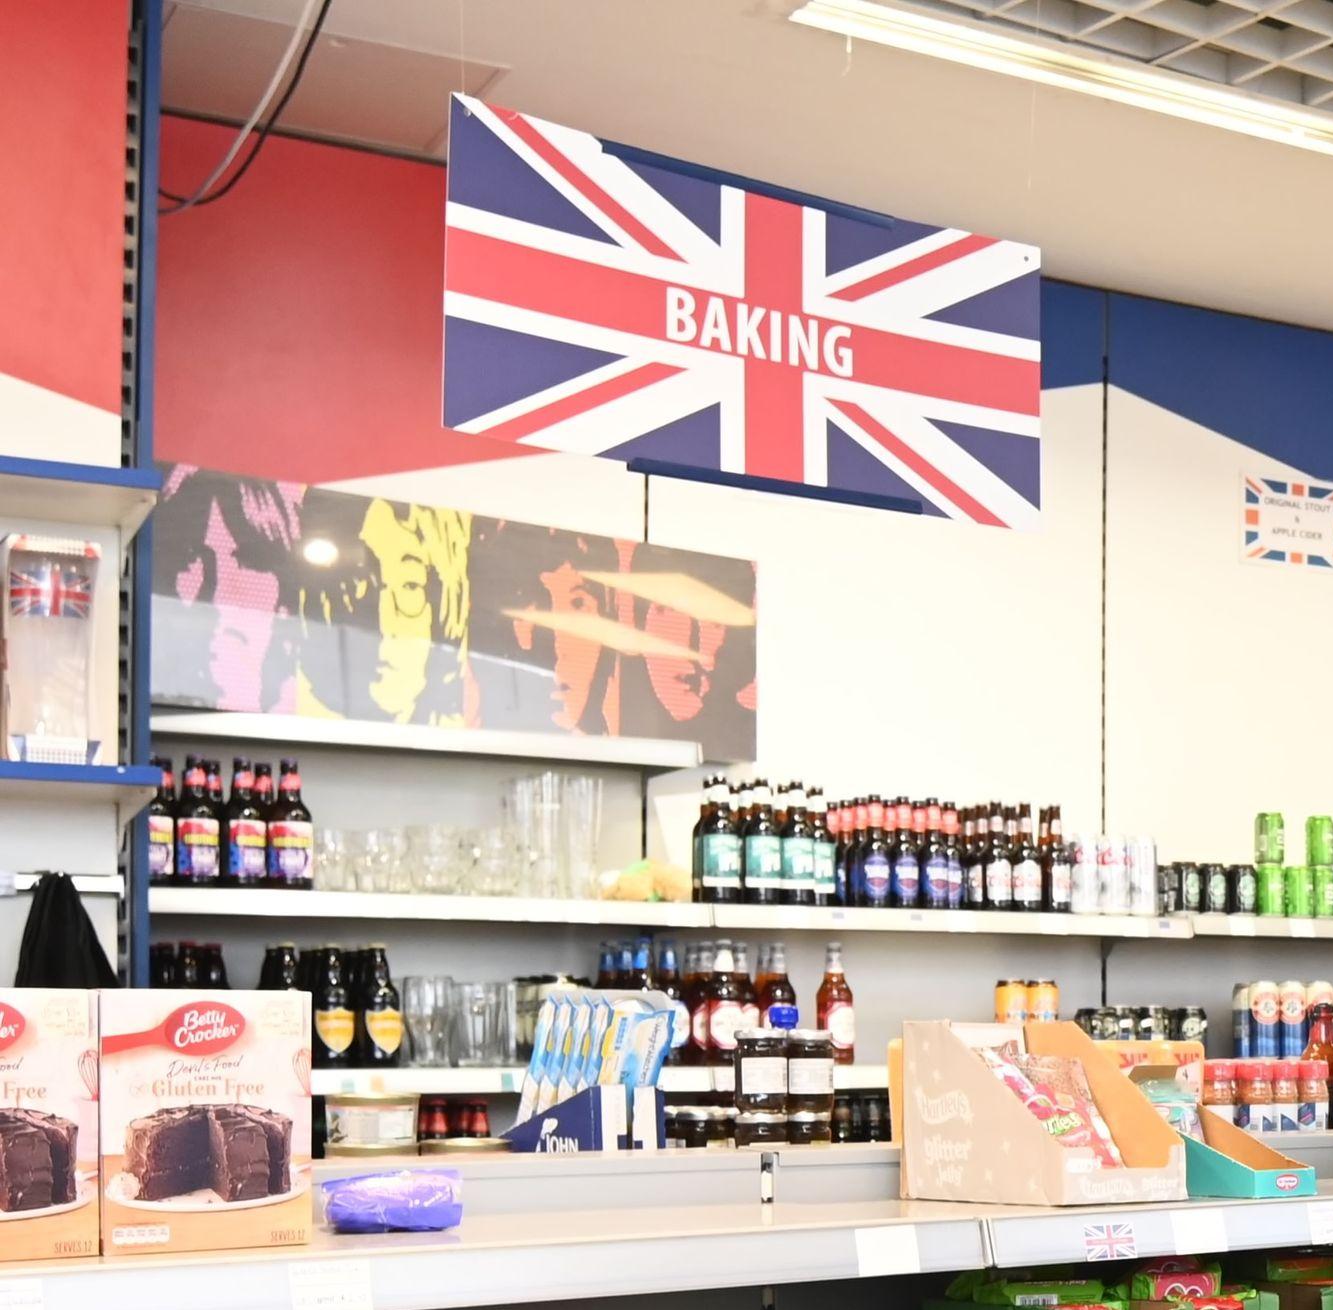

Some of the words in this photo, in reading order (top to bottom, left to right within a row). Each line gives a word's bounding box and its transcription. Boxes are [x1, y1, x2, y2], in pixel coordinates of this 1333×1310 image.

[666, 286, 853, 378] BAKING
[1304, 502, 1331, 513] STOUT
[183, 1010, 226, 1029] Betty
[174, 1024, 236, 1048] Crocker
[214, 1055, 244, 1074] Food
[3, 1081, 47, 1100] Free
[152, 1080, 219, 1097] Gluten
[223, 1079, 264, 1098] Free
[270, 1231, 297, 1243] SERVES
[54, 1240, 83, 1254] SERVES
